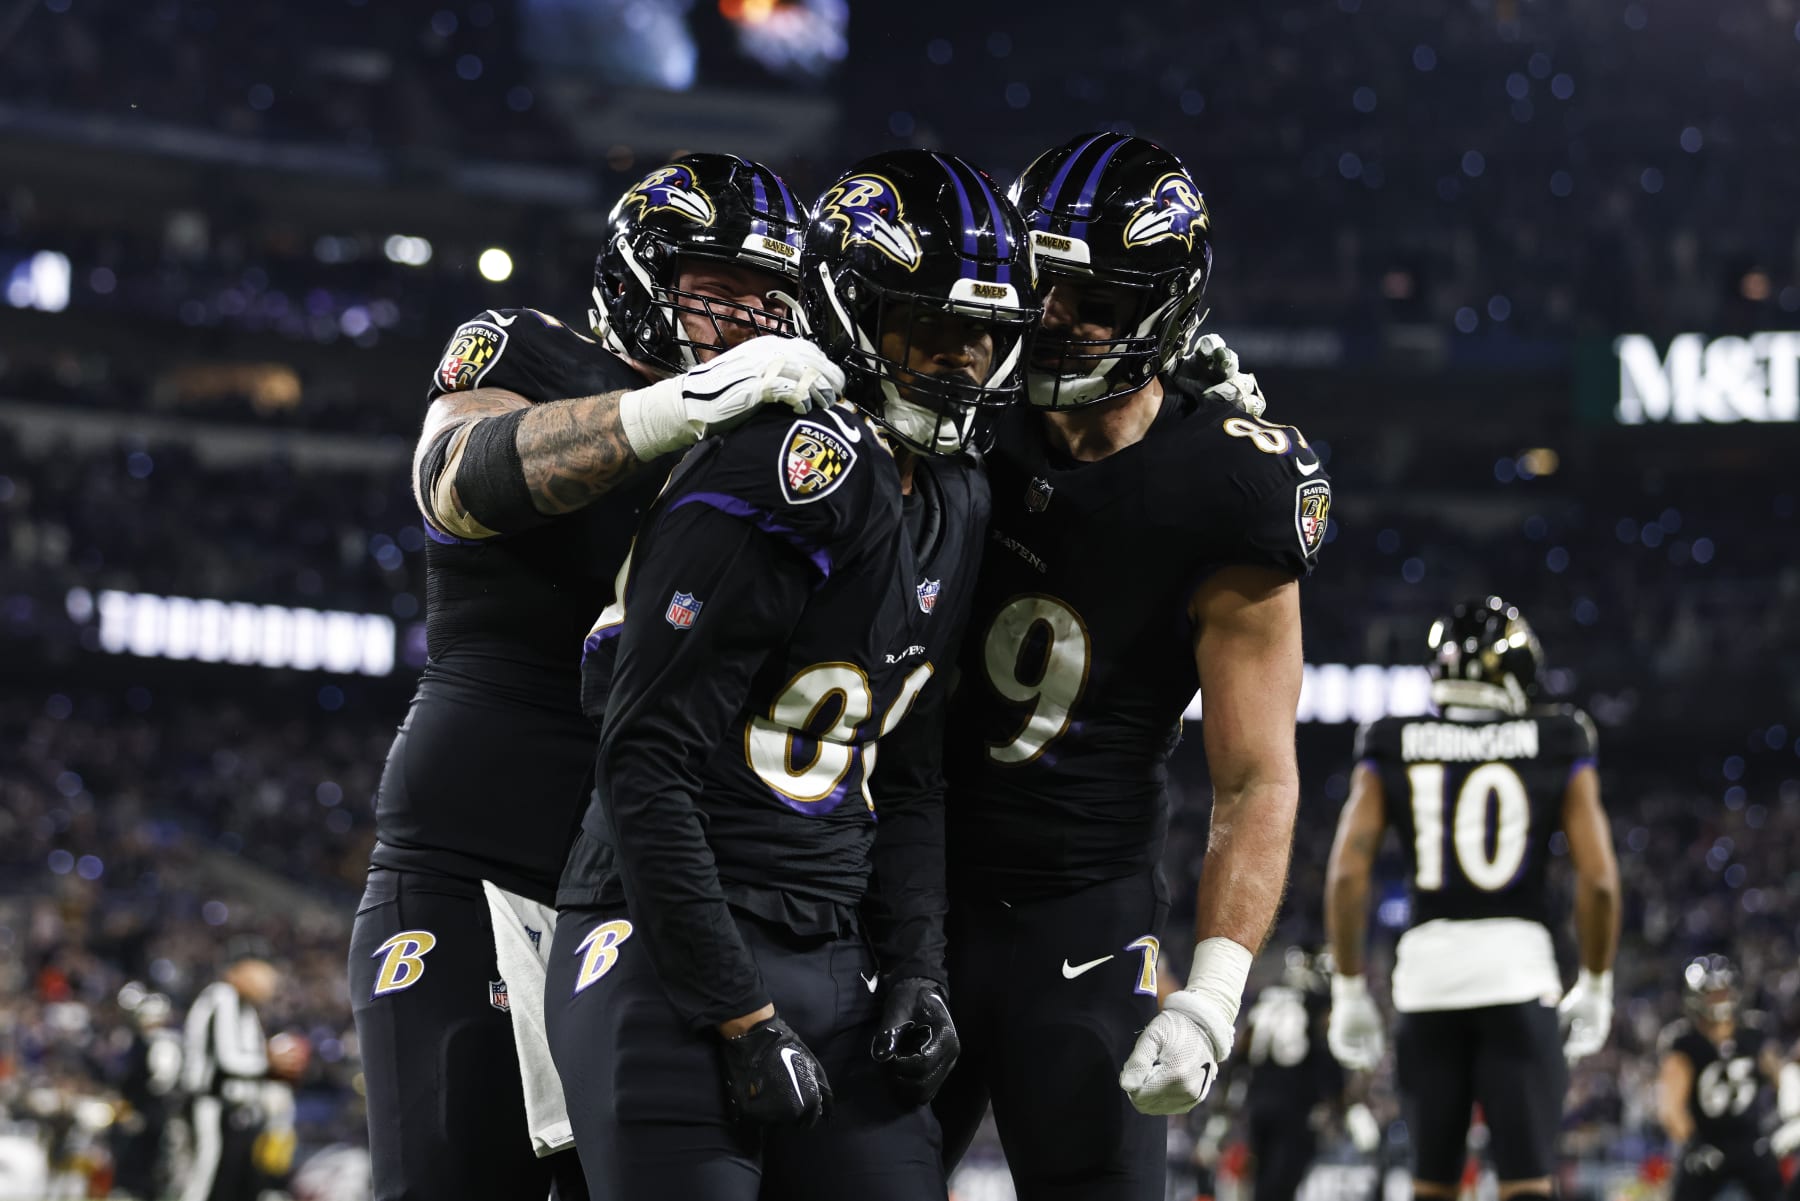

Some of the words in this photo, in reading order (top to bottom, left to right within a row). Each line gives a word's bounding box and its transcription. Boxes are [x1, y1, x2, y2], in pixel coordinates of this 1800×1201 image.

[762, 237, 795, 257] RAVENS
[1035, 233, 1072, 252] RAVENS
[972, 283, 1008, 298] RAVENS
[459, 326, 500, 343] RAVENS
[800, 426, 849, 461] RAVENS
[1302, 486, 1330, 497] RAVEN
[669, 604, 695, 626] NFL
[1401, 719, 1539, 762] ROBINSON
[1406, 760, 1531, 891] 10
